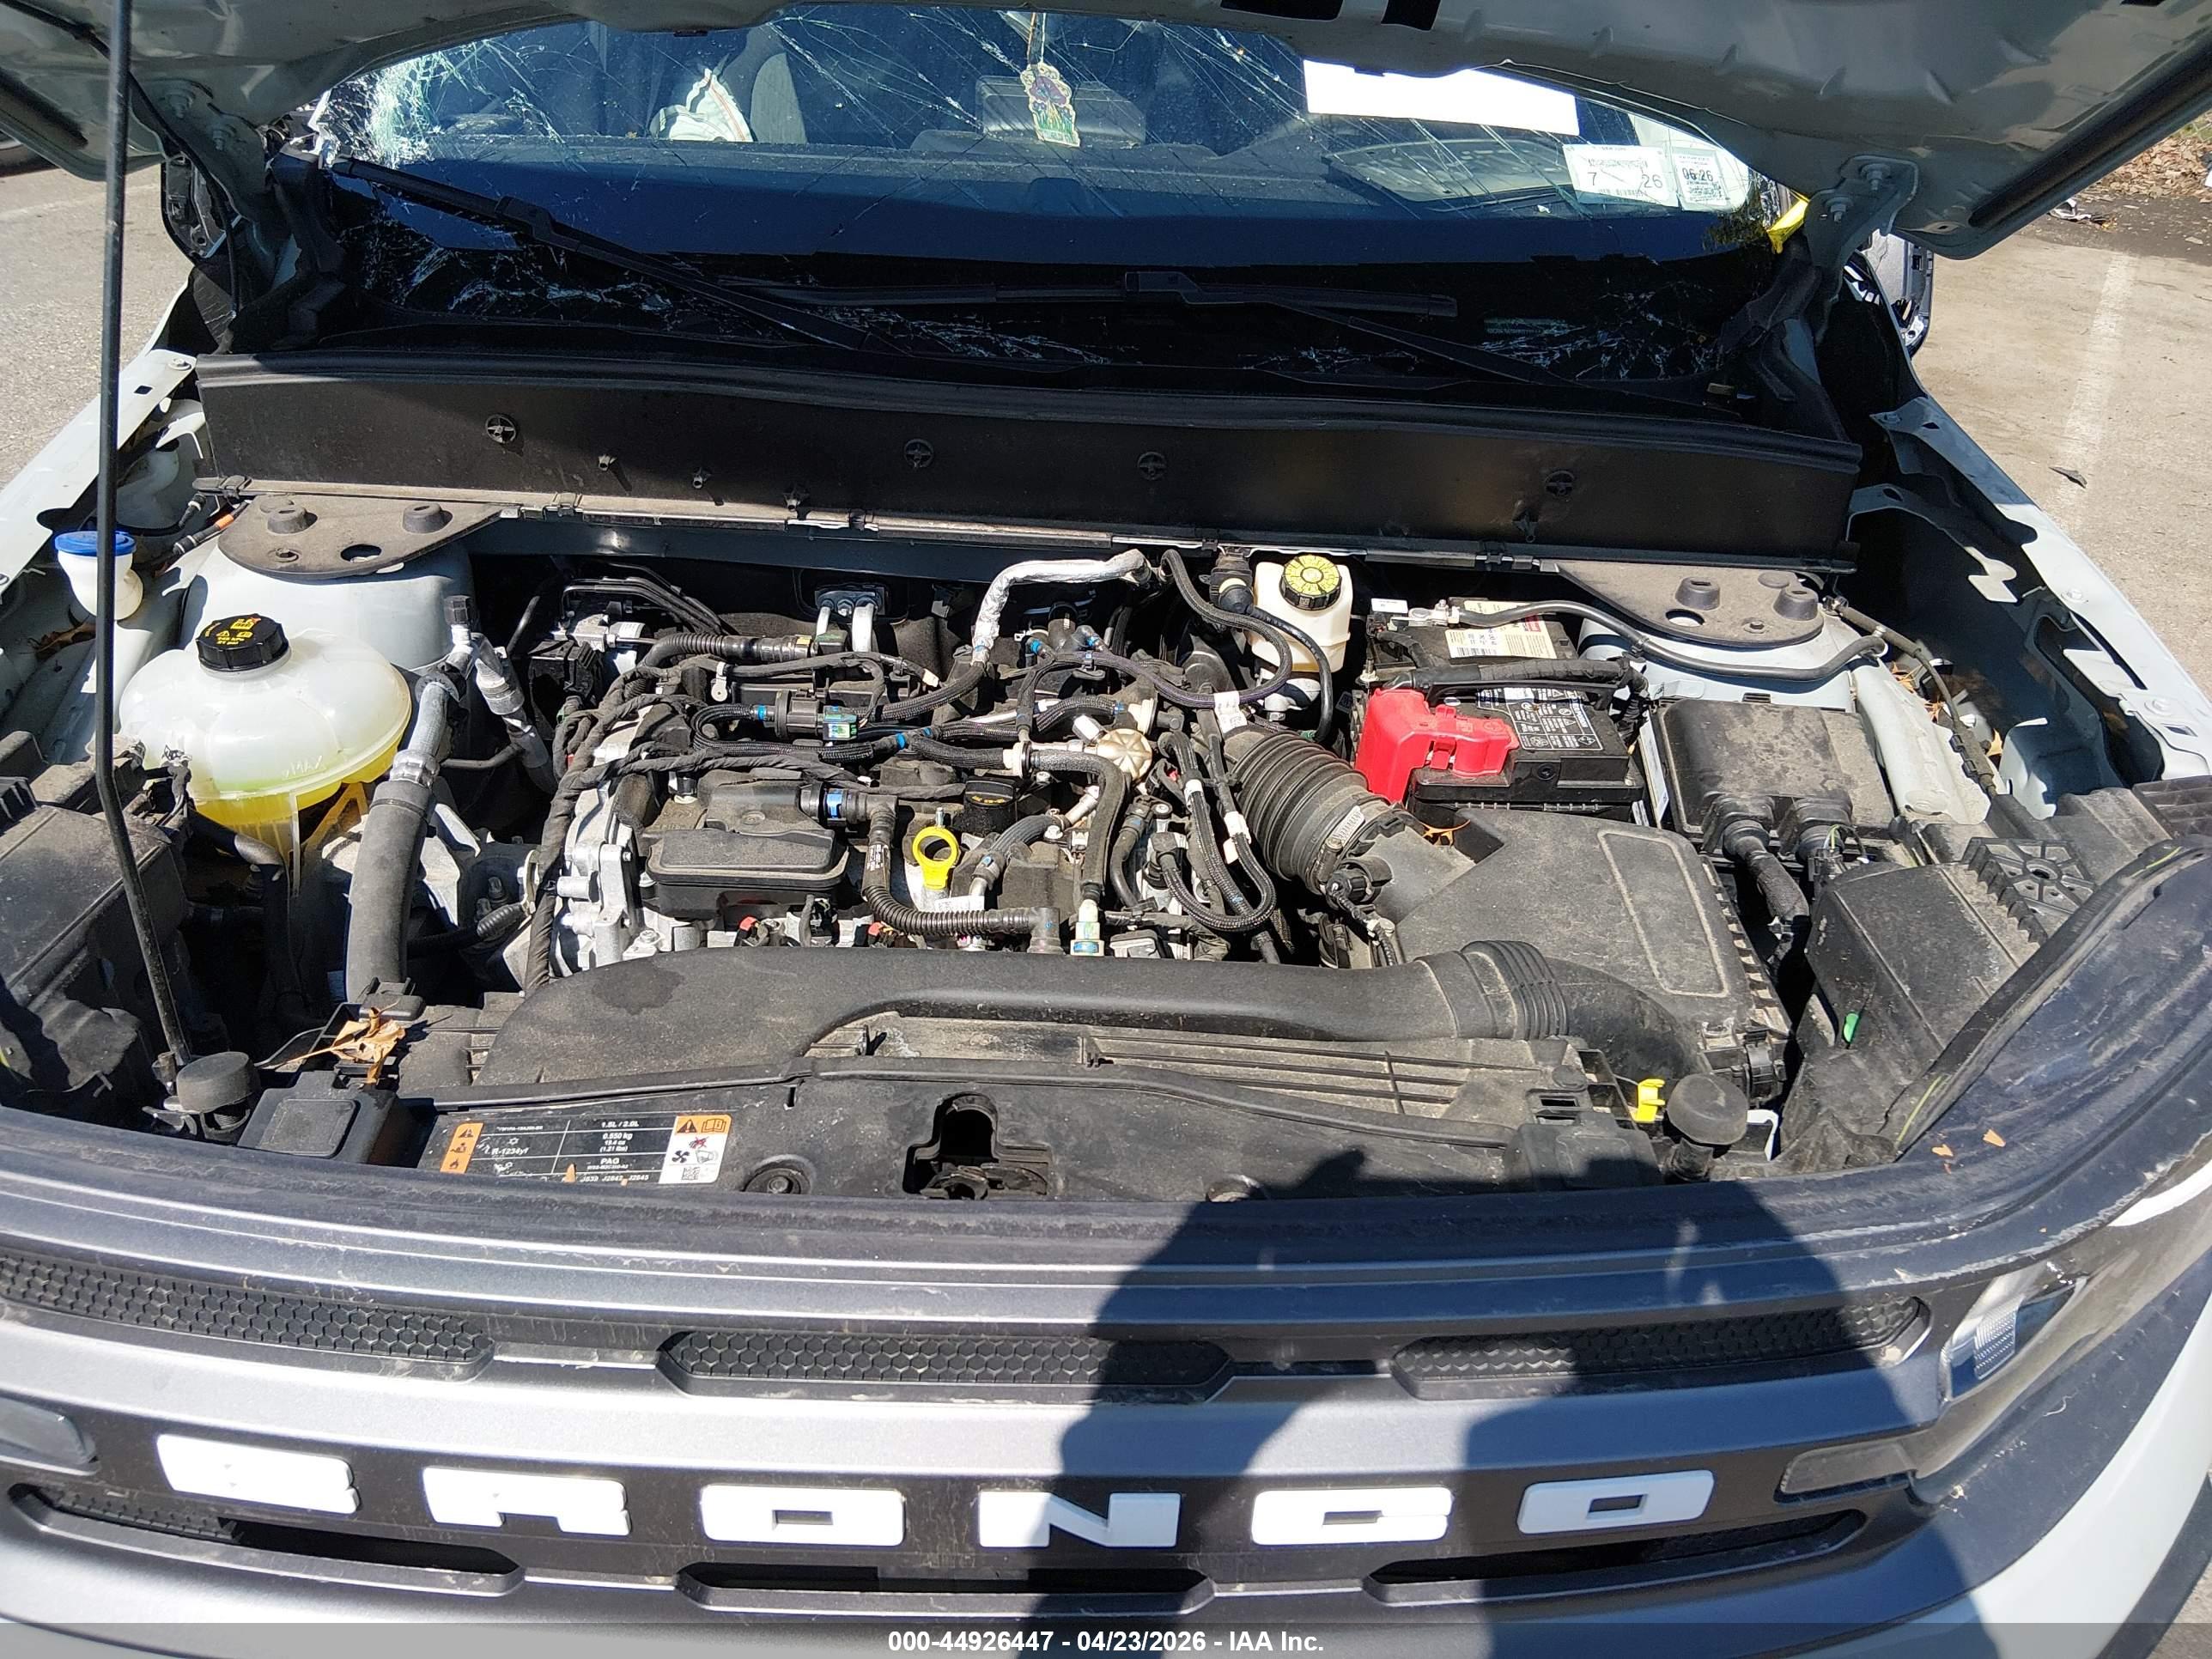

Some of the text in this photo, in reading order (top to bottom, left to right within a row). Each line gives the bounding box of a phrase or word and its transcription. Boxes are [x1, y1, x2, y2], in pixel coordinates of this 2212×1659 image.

[1587, 172, 1663, 188] 7 26
[600, 1157, 620, 1165] PAG
[156, 1433, 1715, 1549] BRONCO
